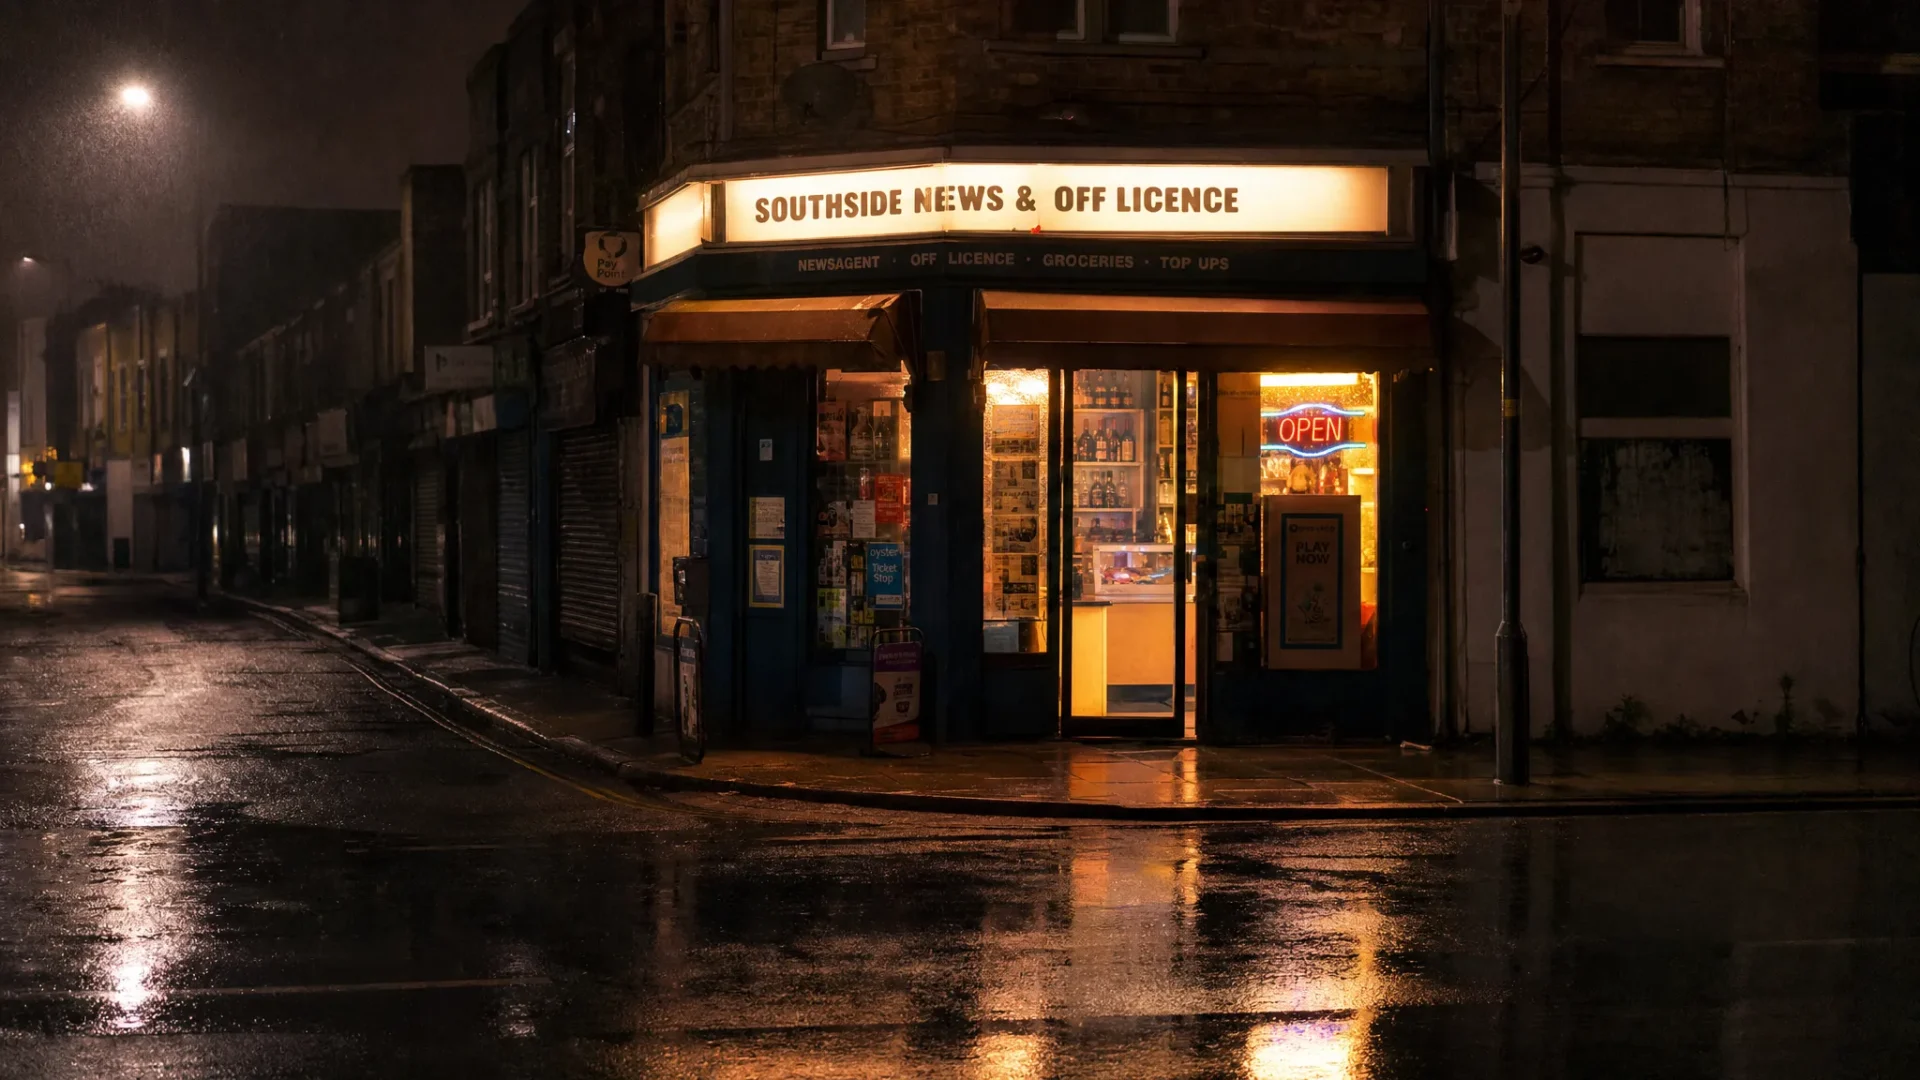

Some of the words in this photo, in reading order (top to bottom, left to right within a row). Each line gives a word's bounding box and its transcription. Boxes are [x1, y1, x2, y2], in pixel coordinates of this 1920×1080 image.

[755, 189, 902, 223] SOUTHSIDE
[914, 185, 1004, 214] NEWS
[1015, 185, 1036, 212] &
[1054, 186, 1106, 212] OFF
[1116, 186, 1239, 213] LICENCE
[597, 258, 617, 270] Pay
[798, 255, 880, 272] NEWSAGENT
[910, 252, 937, 266] OFF
[948, 251, 1015, 266] LICENCE
[1042, 253, 1134, 269] GROCERIES
[1160, 256, 1192, 269] TOP
[1198, 257, 1229, 271] UPS
[1279, 416, 1341, 442] OPEN
[870, 546, 898, 560] oyster
[1295, 541, 1330, 553] PLAY
[1295, 553, 1330, 565] NOW
[872, 562, 898, 573] Ticket
[873, 573, 894, 586] Stop
